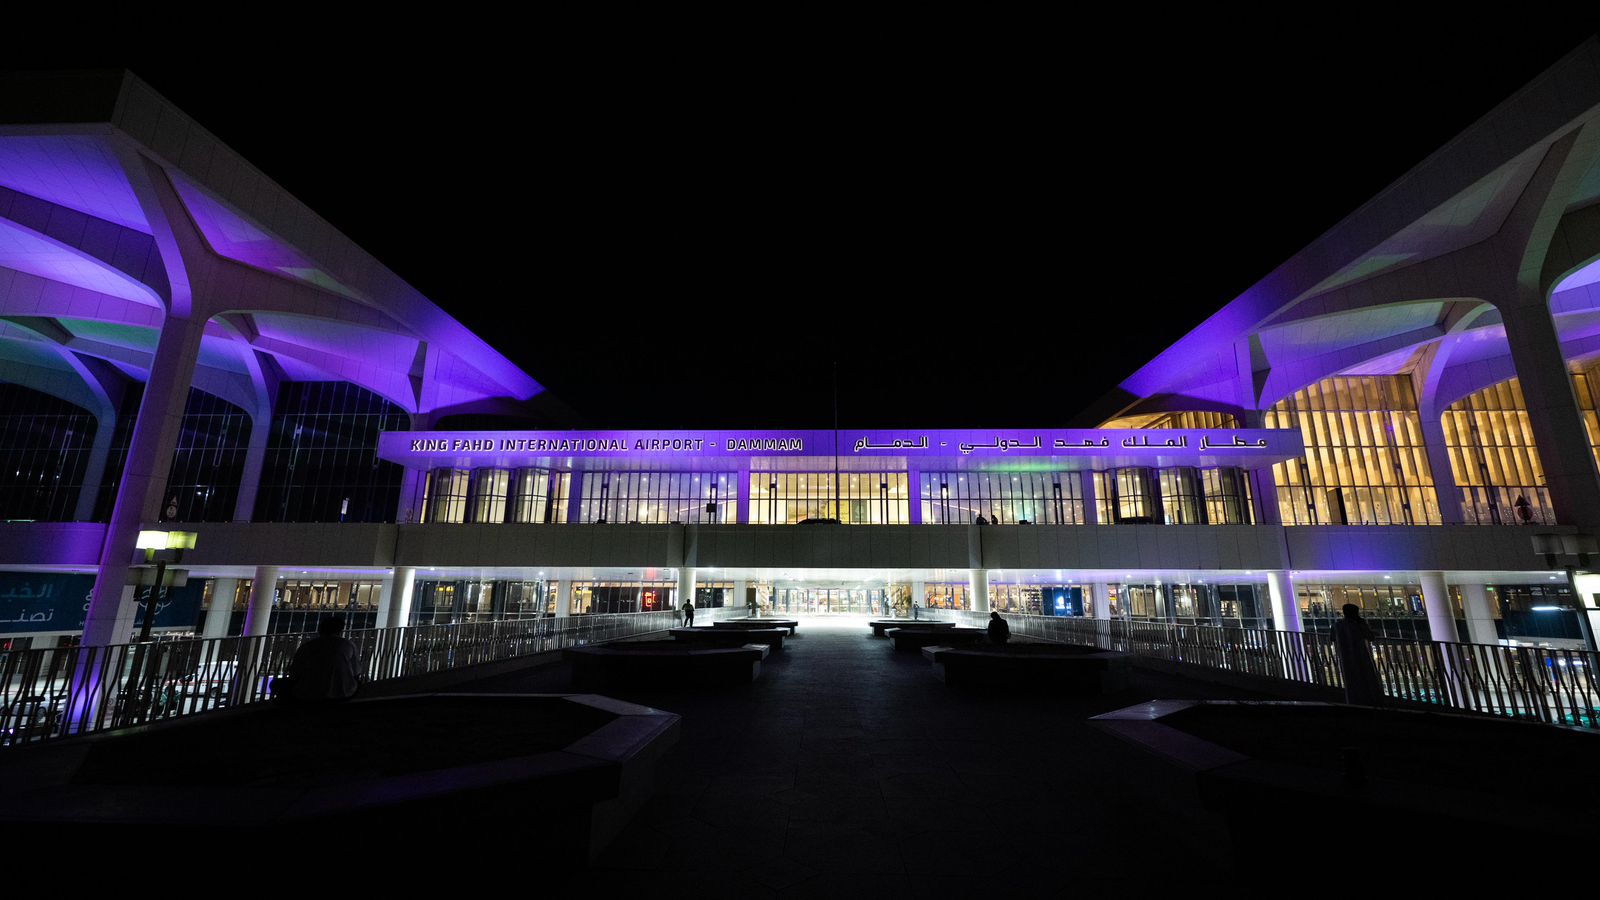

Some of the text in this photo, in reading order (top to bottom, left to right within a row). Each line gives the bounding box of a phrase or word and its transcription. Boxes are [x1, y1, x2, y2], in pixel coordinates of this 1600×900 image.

[411, 439, 448, 451] KING
[452, 439, 495, 451] FAHD
[500, 439, 629, 451] INTERNATIONAL
[634, 439, 703, 451] AIRPORT
[726, 438, 803, 451] DAMMAM
[853, 436, 929, 452] الدمام
[959, 436, 1042, 455] الدولي
[1053, 436, 1110, 449] فهد
[1121, 435, 1188, 449] الملك
[1198, 435, 1268, 451] مطار
